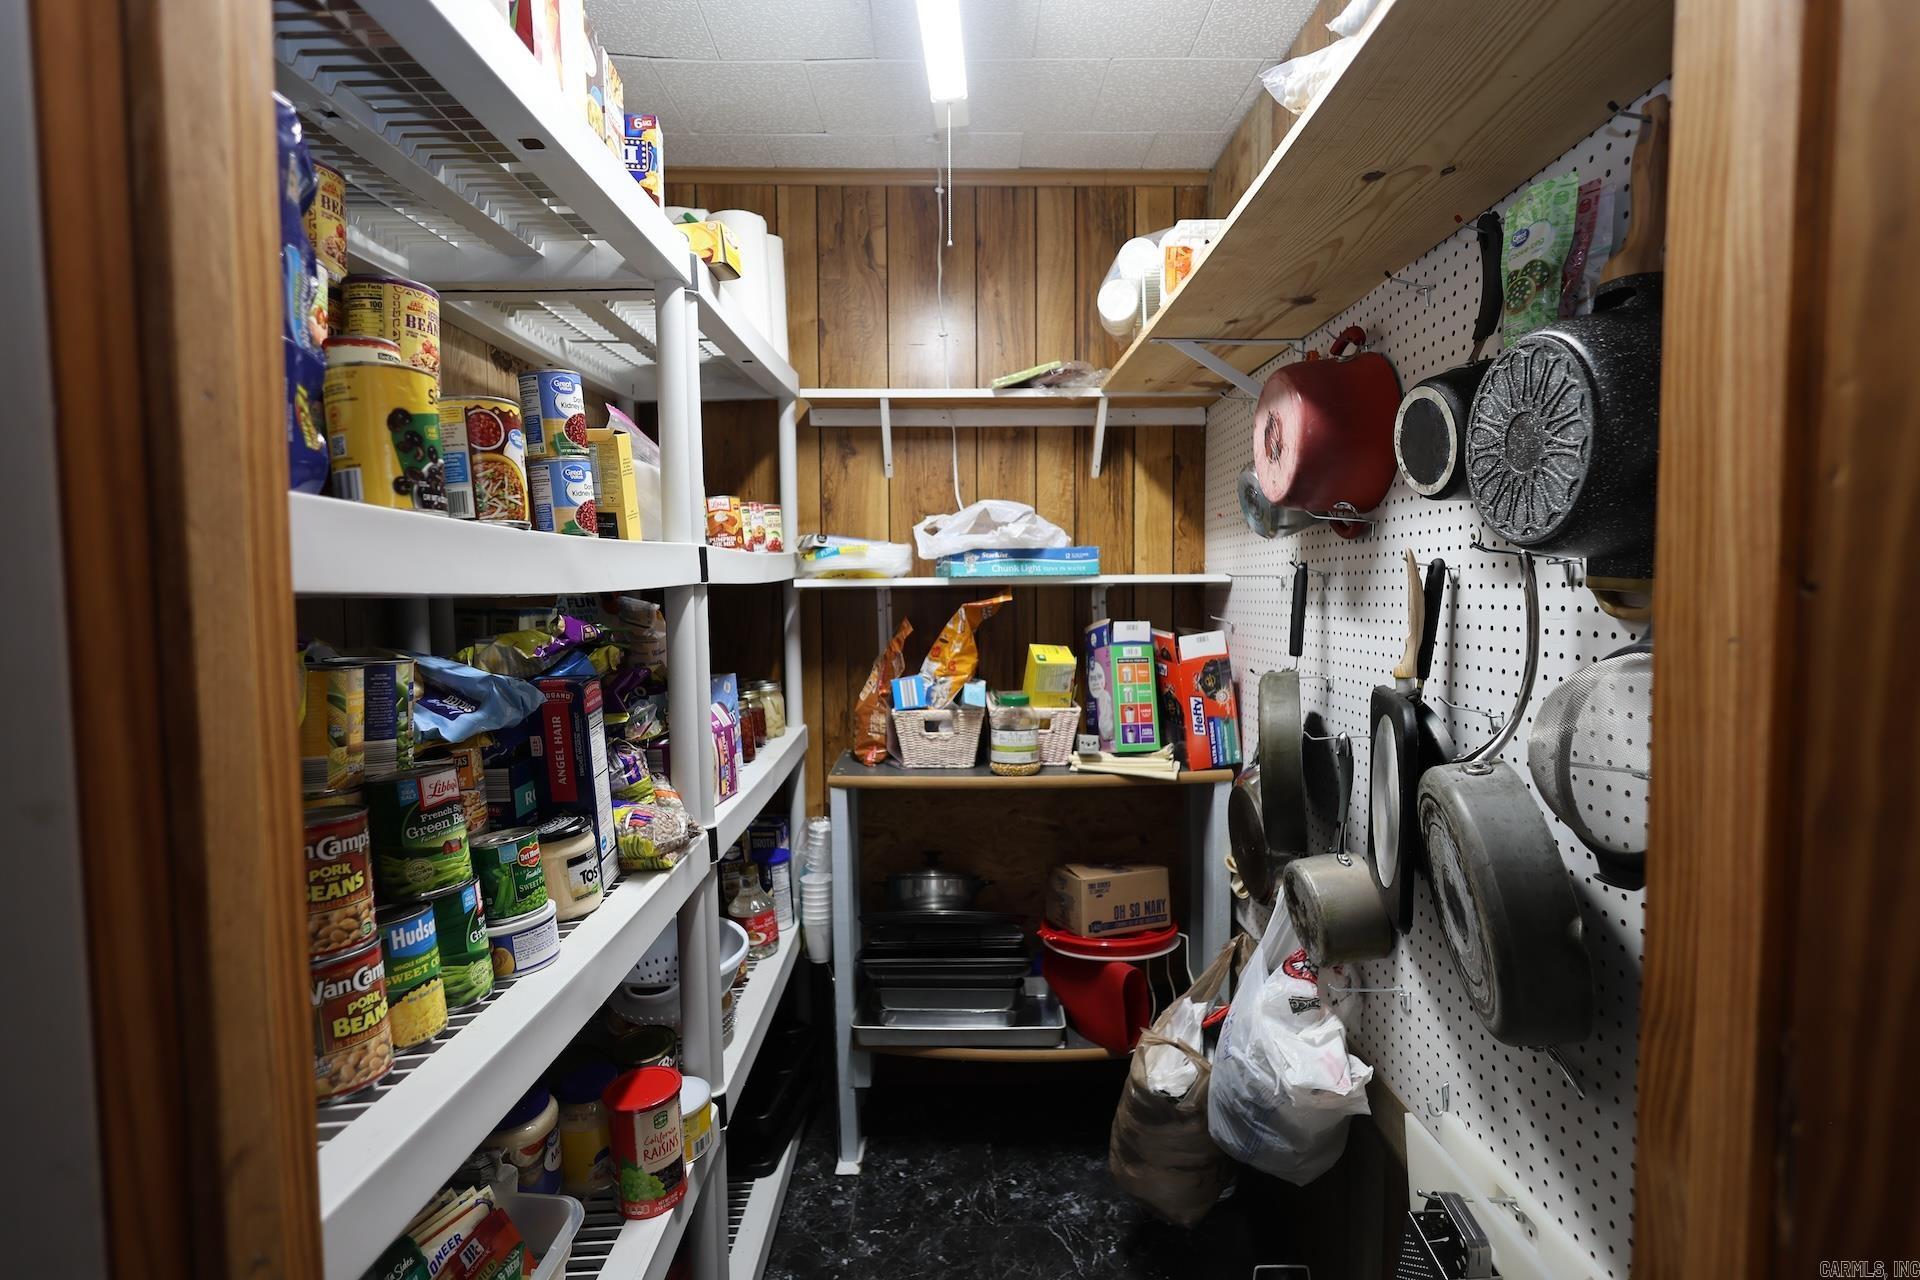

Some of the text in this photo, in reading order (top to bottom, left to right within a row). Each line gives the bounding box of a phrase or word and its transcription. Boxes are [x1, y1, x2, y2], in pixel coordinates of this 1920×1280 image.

[369, 300, 384, 310] 100
[564, 469, 583, 478] Great
[1021, 566, 1042, 575] Light
[1193, 698, 1204, 734] Hefty
[551, 715, 568, 785] ANGEL HAIR
[420, 806, 452, 822] French
[406, 818, 451, 840] Green
[309, 863, 352, 882] PORK
[306, 870, 365, 902] EANS
[1113, 898, 1167, 920] OH SO MANY
[384, 963, 429, 987] SWEET
[347, 990, 381, 1016] PORK
[643, 1127, 677, 1147] California
[643, 1134, 680, 1162] RAISINS
